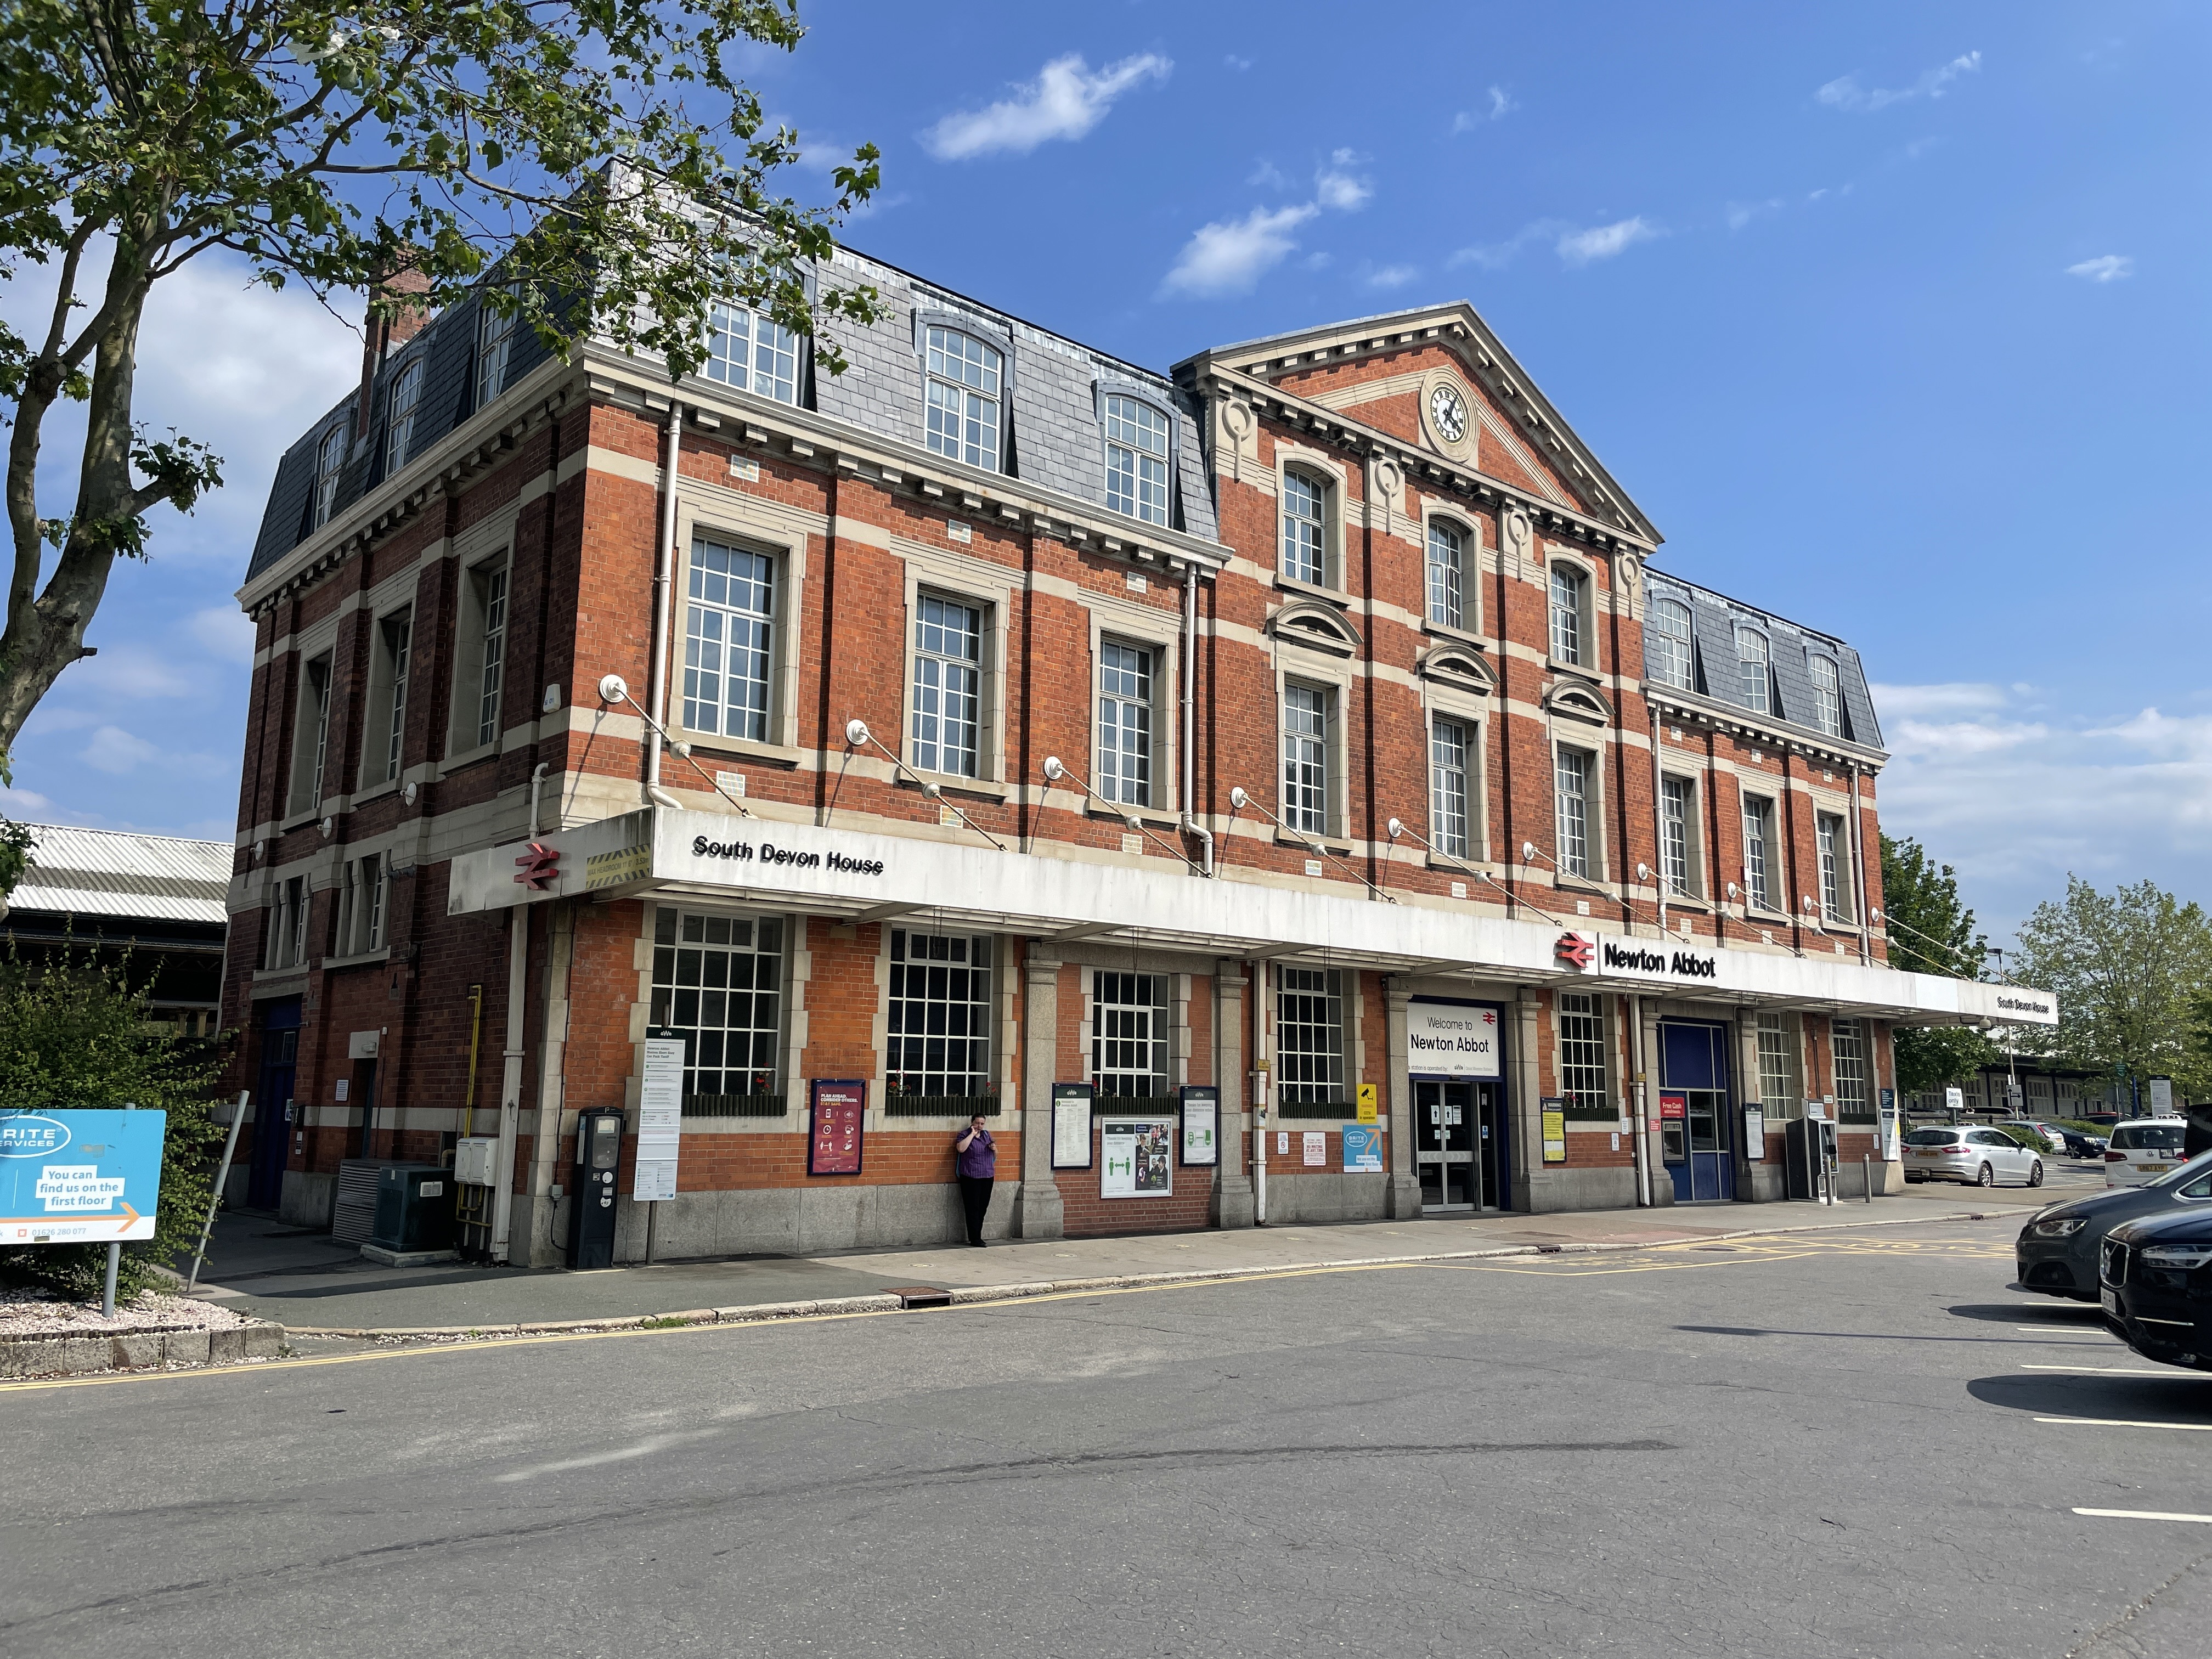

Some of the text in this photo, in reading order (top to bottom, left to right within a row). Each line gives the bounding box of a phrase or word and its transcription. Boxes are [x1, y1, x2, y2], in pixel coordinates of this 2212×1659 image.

[692, 836, 884, 875] South Devon House
[597, 862, 621, 873] HEADROOM
[1605, 943, 1716, 978] Newton Abbot
[1997, 996, 2049, 1014] South Devon House
[1427, 1017, 1472, 1031] Welcome to
[1410, 1034, 1489, 1053] Newton Abbot
[48, 1171, 69, 1180] You
[40, 1183, 63, 1193] find
[100, 1183, 119, 1192] the
[51, 1196, 106, 1206] first floor
